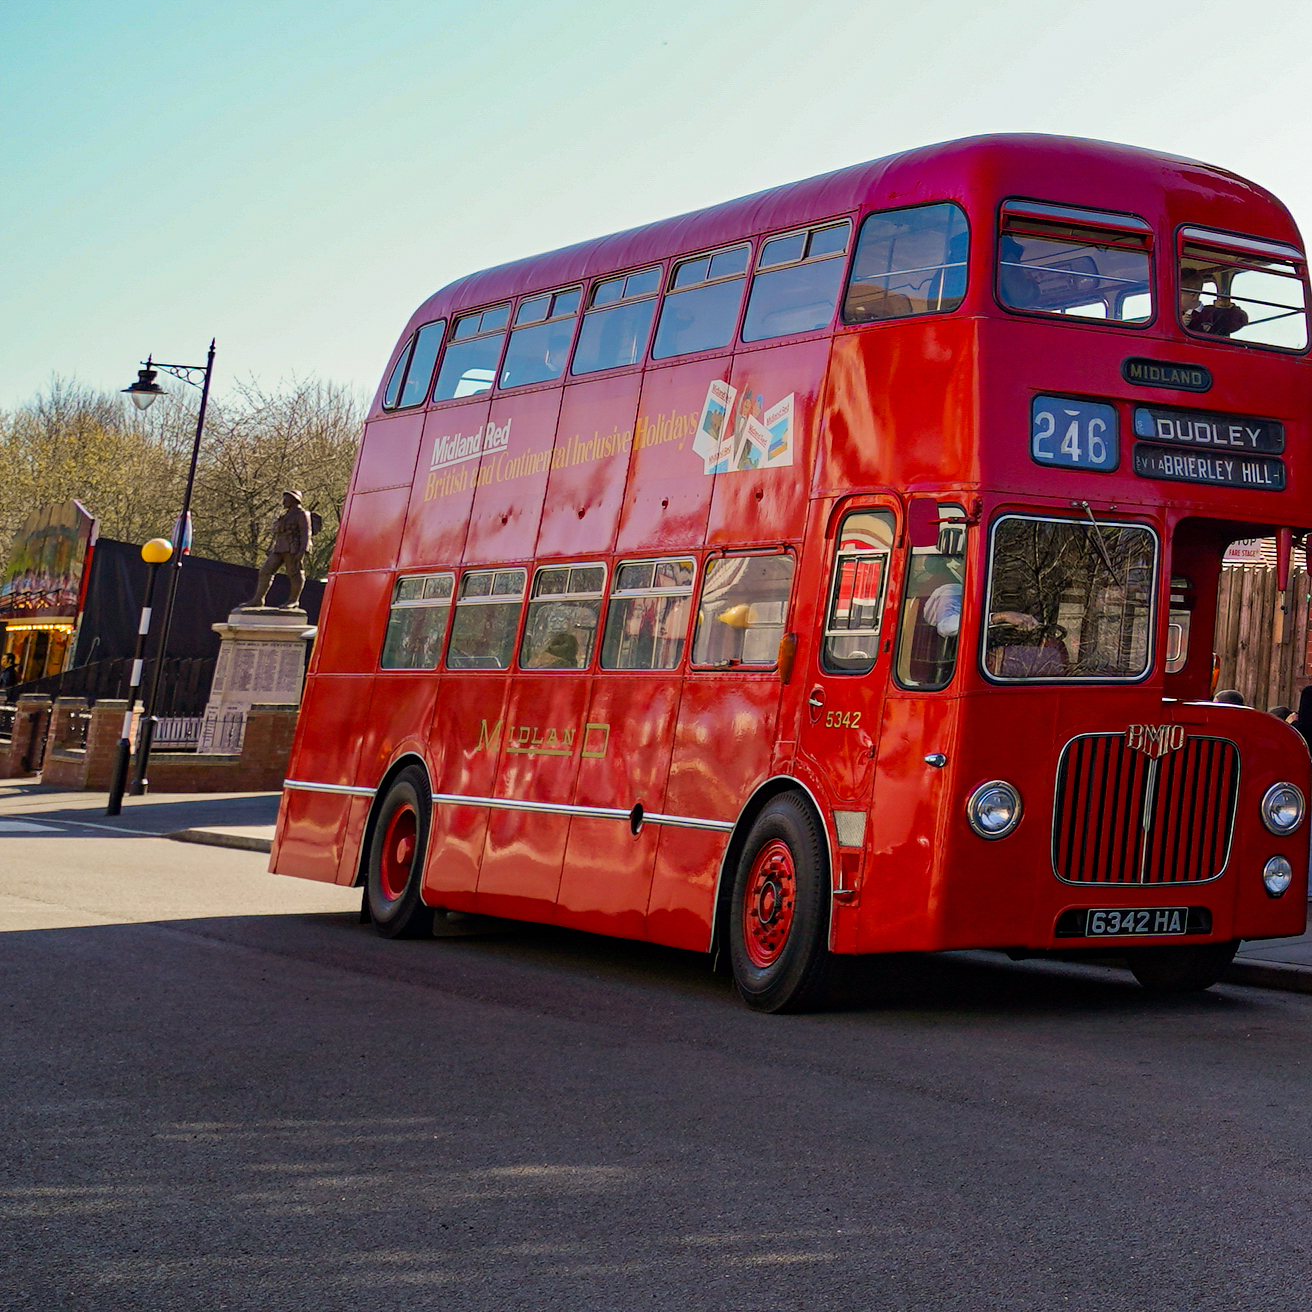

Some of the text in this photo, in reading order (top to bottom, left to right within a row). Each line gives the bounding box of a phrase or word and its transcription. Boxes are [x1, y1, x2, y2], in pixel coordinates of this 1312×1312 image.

[1130, 363, 1202, 386] MIDLAND
[431, 418, 512, 465] Midland Red
[1033, 411, 1107, 464] 246
[1157, 419, 1262, 448] DUDLEY
[424, 410, 699, 502] British and Continental Inclusive Holidays
[1163, 455, 1234, 481] BRIERLEY
[1242, 462, 1272, 485] HILL
[825, 710, 862, 729] 5342
[1091, 910, 1181, 934] 6342 HA
